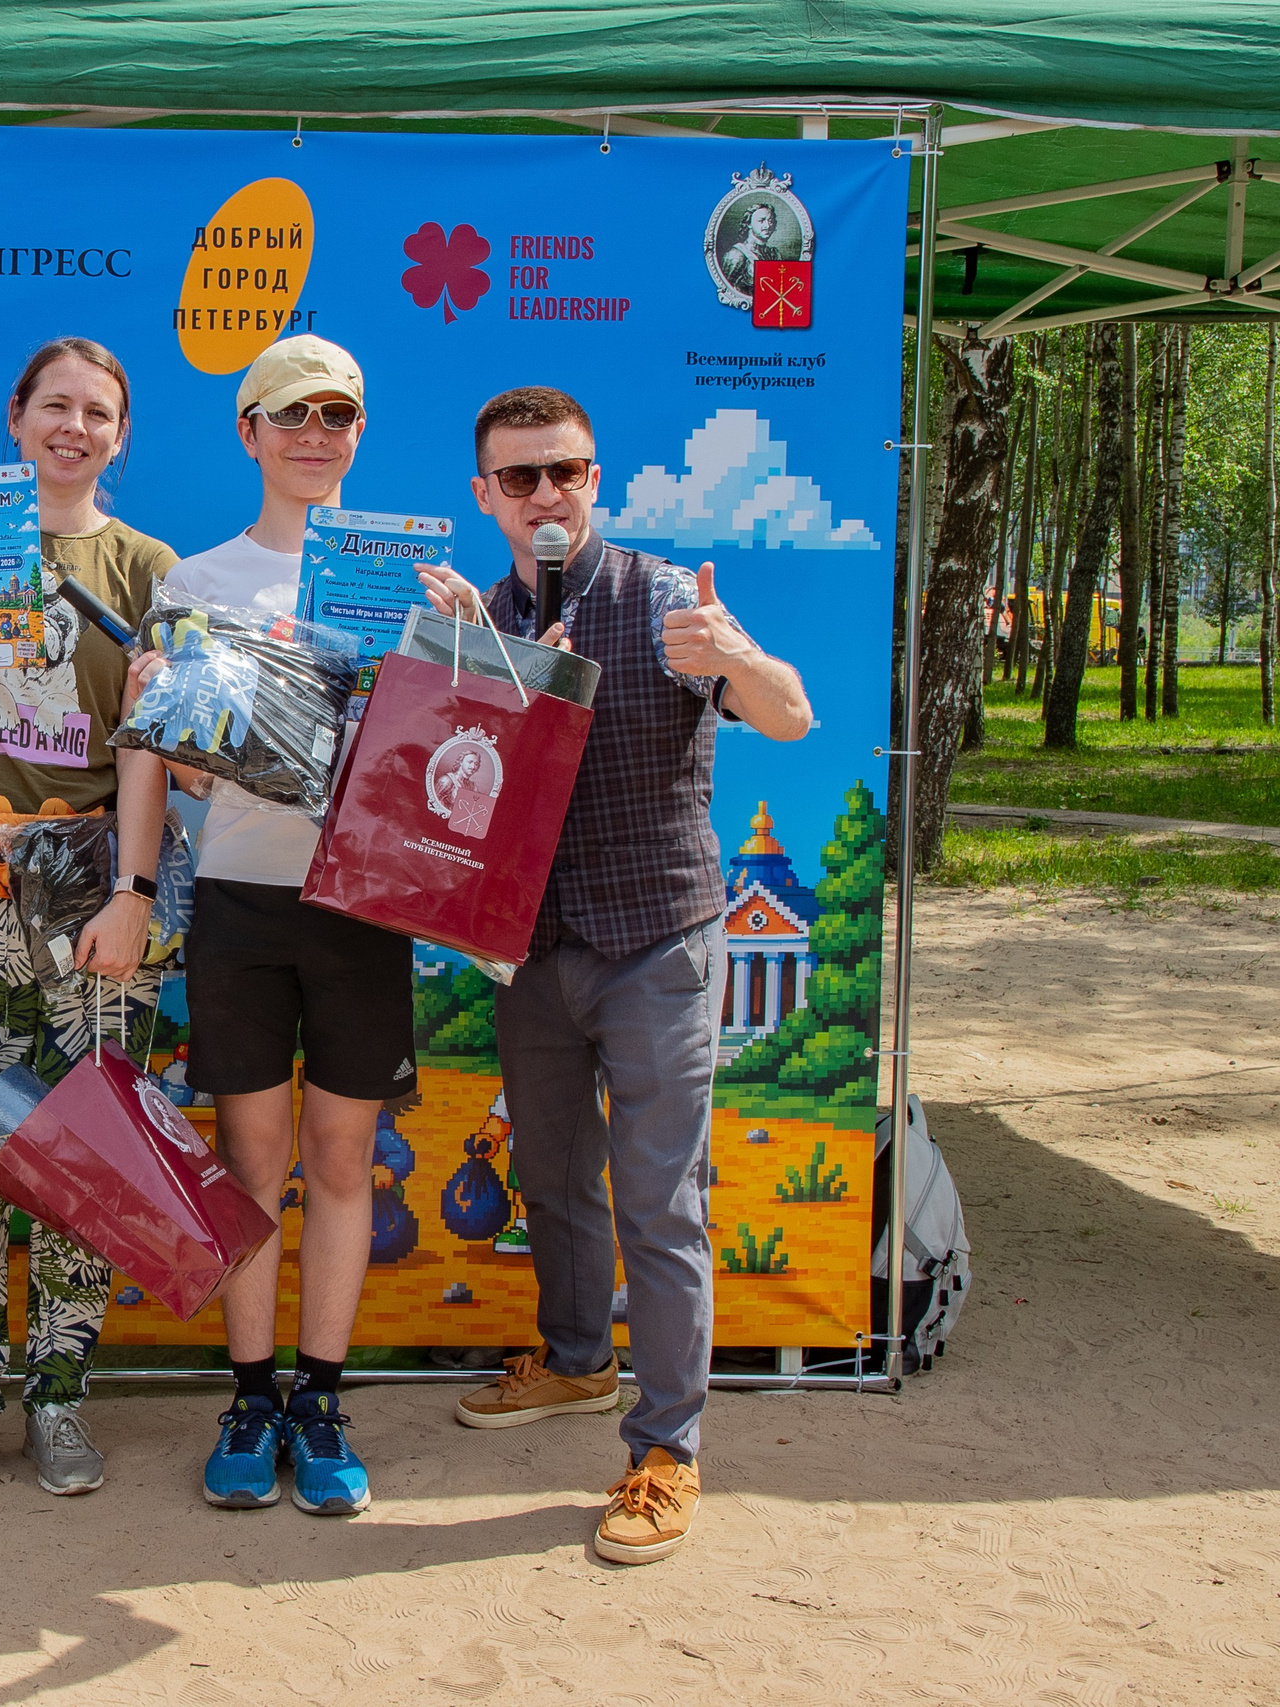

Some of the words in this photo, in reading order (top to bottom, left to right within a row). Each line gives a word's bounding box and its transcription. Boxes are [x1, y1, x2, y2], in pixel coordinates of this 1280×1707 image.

[191, 222, 303, 252] ДОБРЫЙ
[510, 234, 595, 260] FRIENDS
[203, 268, 289, 294] ГОРОД
[510, 265, 549, 290] FOR
[172, 308, 318, 332] ПЕТЕРБУРГ
[509, 296, 631, 322] LEADERSHIP
[685, 351, 783, 369] Всемирный
[787, 353, 826, 370] клуб
[694, 372, 816, 390] петербуржцев
[340, 533, 425, 560] Диплом
[325, 579, 349, 587] Команда
[355, 567, 401, 578] Награждается
[330, 606, 355, 616] Чистые
[356, 608, 373, 619] Игры
[384, 612, 402, 620] ПМЭФ
[36, 728, 48, 750] A
[403, 840, 424, 852] КЛУБ
[424, 846, 484, 870] ПЕТЕРБУРЖЦЕВ
[420, 836, 471, 858] ВСЕМИРНЫЙ
[393, 1066, 414, 1080] adidas
